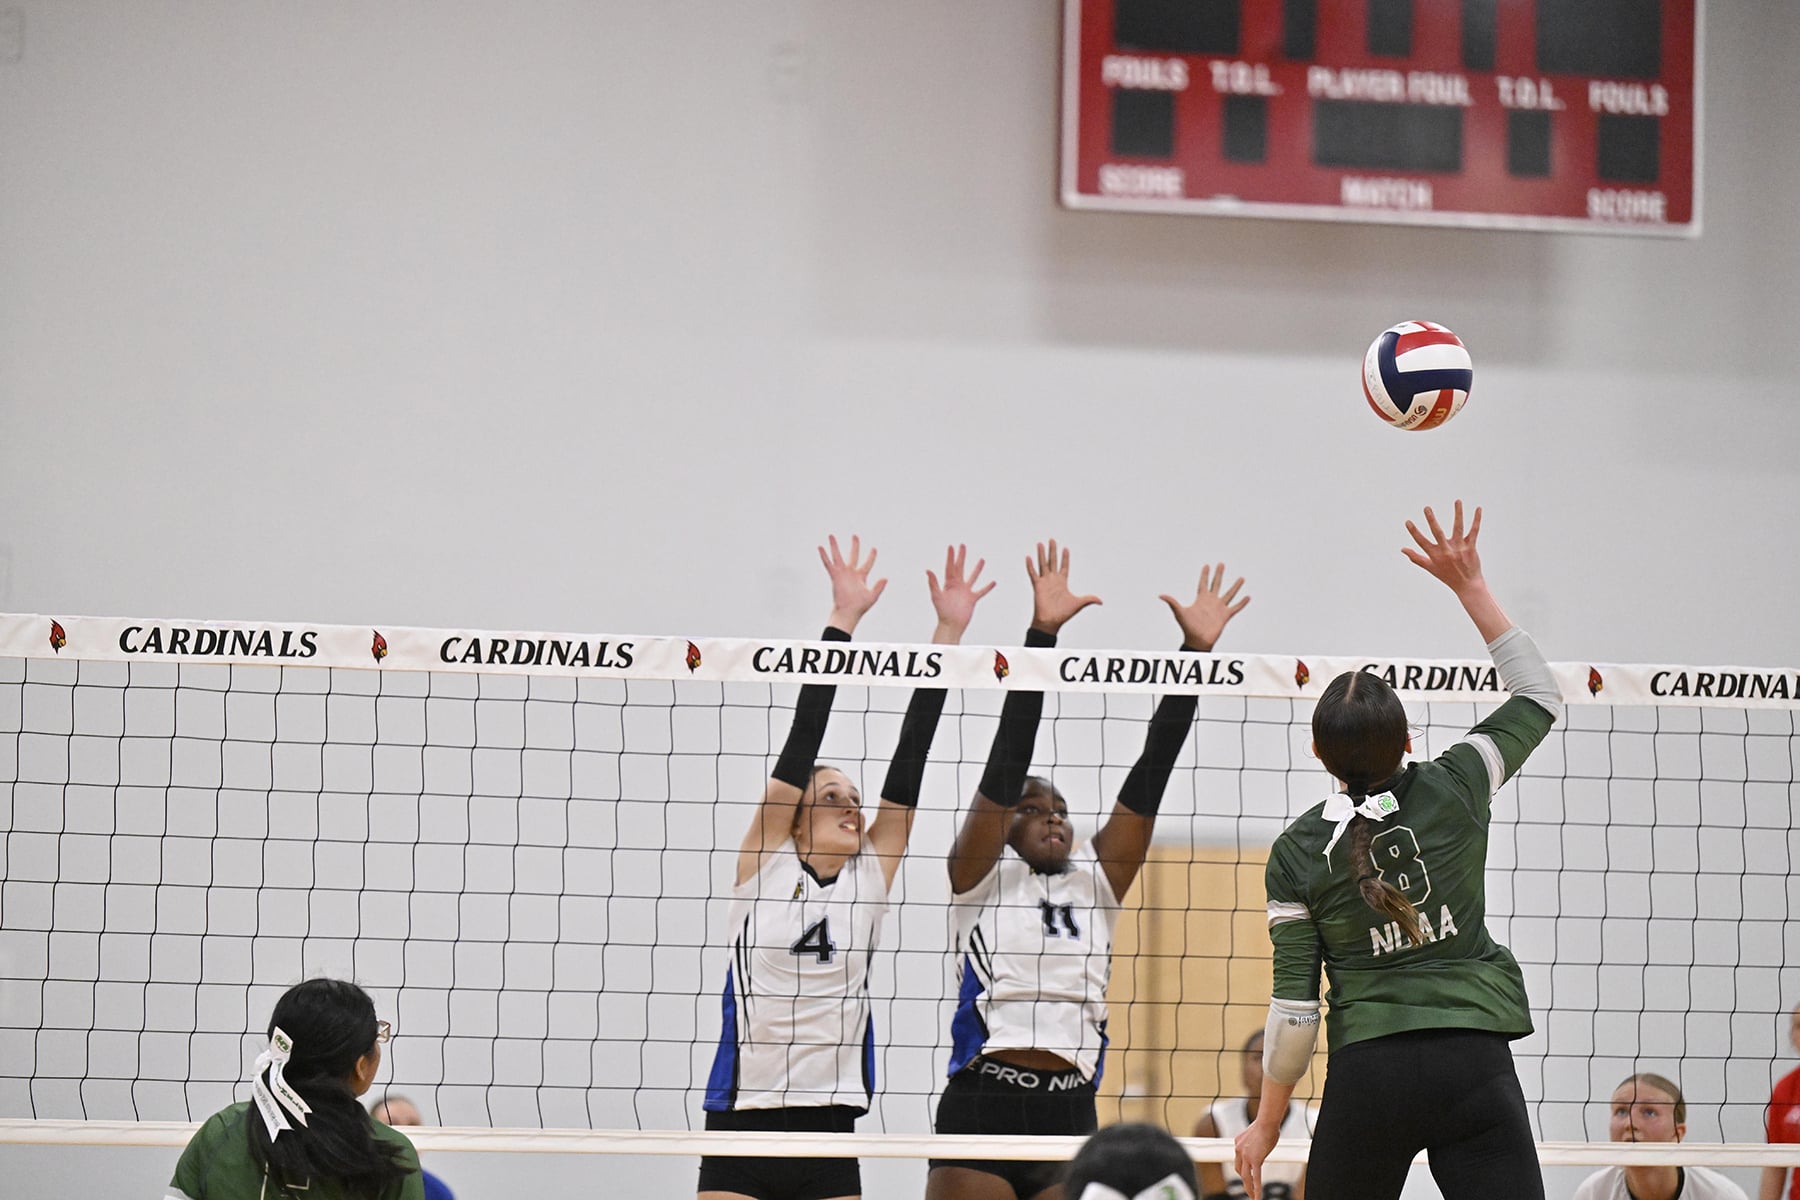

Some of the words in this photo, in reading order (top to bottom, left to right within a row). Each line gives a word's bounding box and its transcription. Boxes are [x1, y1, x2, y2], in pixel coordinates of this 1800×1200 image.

[1102, 55, 1189, 91] FOULS
[1308, 65, 1405, 101] PLAYER
[1407, 71, 1474, 106] FOUL
[1588, 81, 1669, 116] FOULS
[1099, 164, 1184, 197] SCORE
[1341, 177, 1433, 210] MATCH
[1587, 188, 1666, 221] SCORE
[119, 626, 318, 658] CARDINALS
[440, 637, 634, 669] CARDINALS
[752, 646, 943, 678] CARDINALS
[1059, 656, 1245, 686] CARDINALS
[1360, 664, 1509, 692] ARDINA
[1369, 825, 1432, 908] 8
[1039, 898, 1080, 941] 11
[790, 915, 836, 964] 4
[980, 1062, 1040, 1089] PRO
